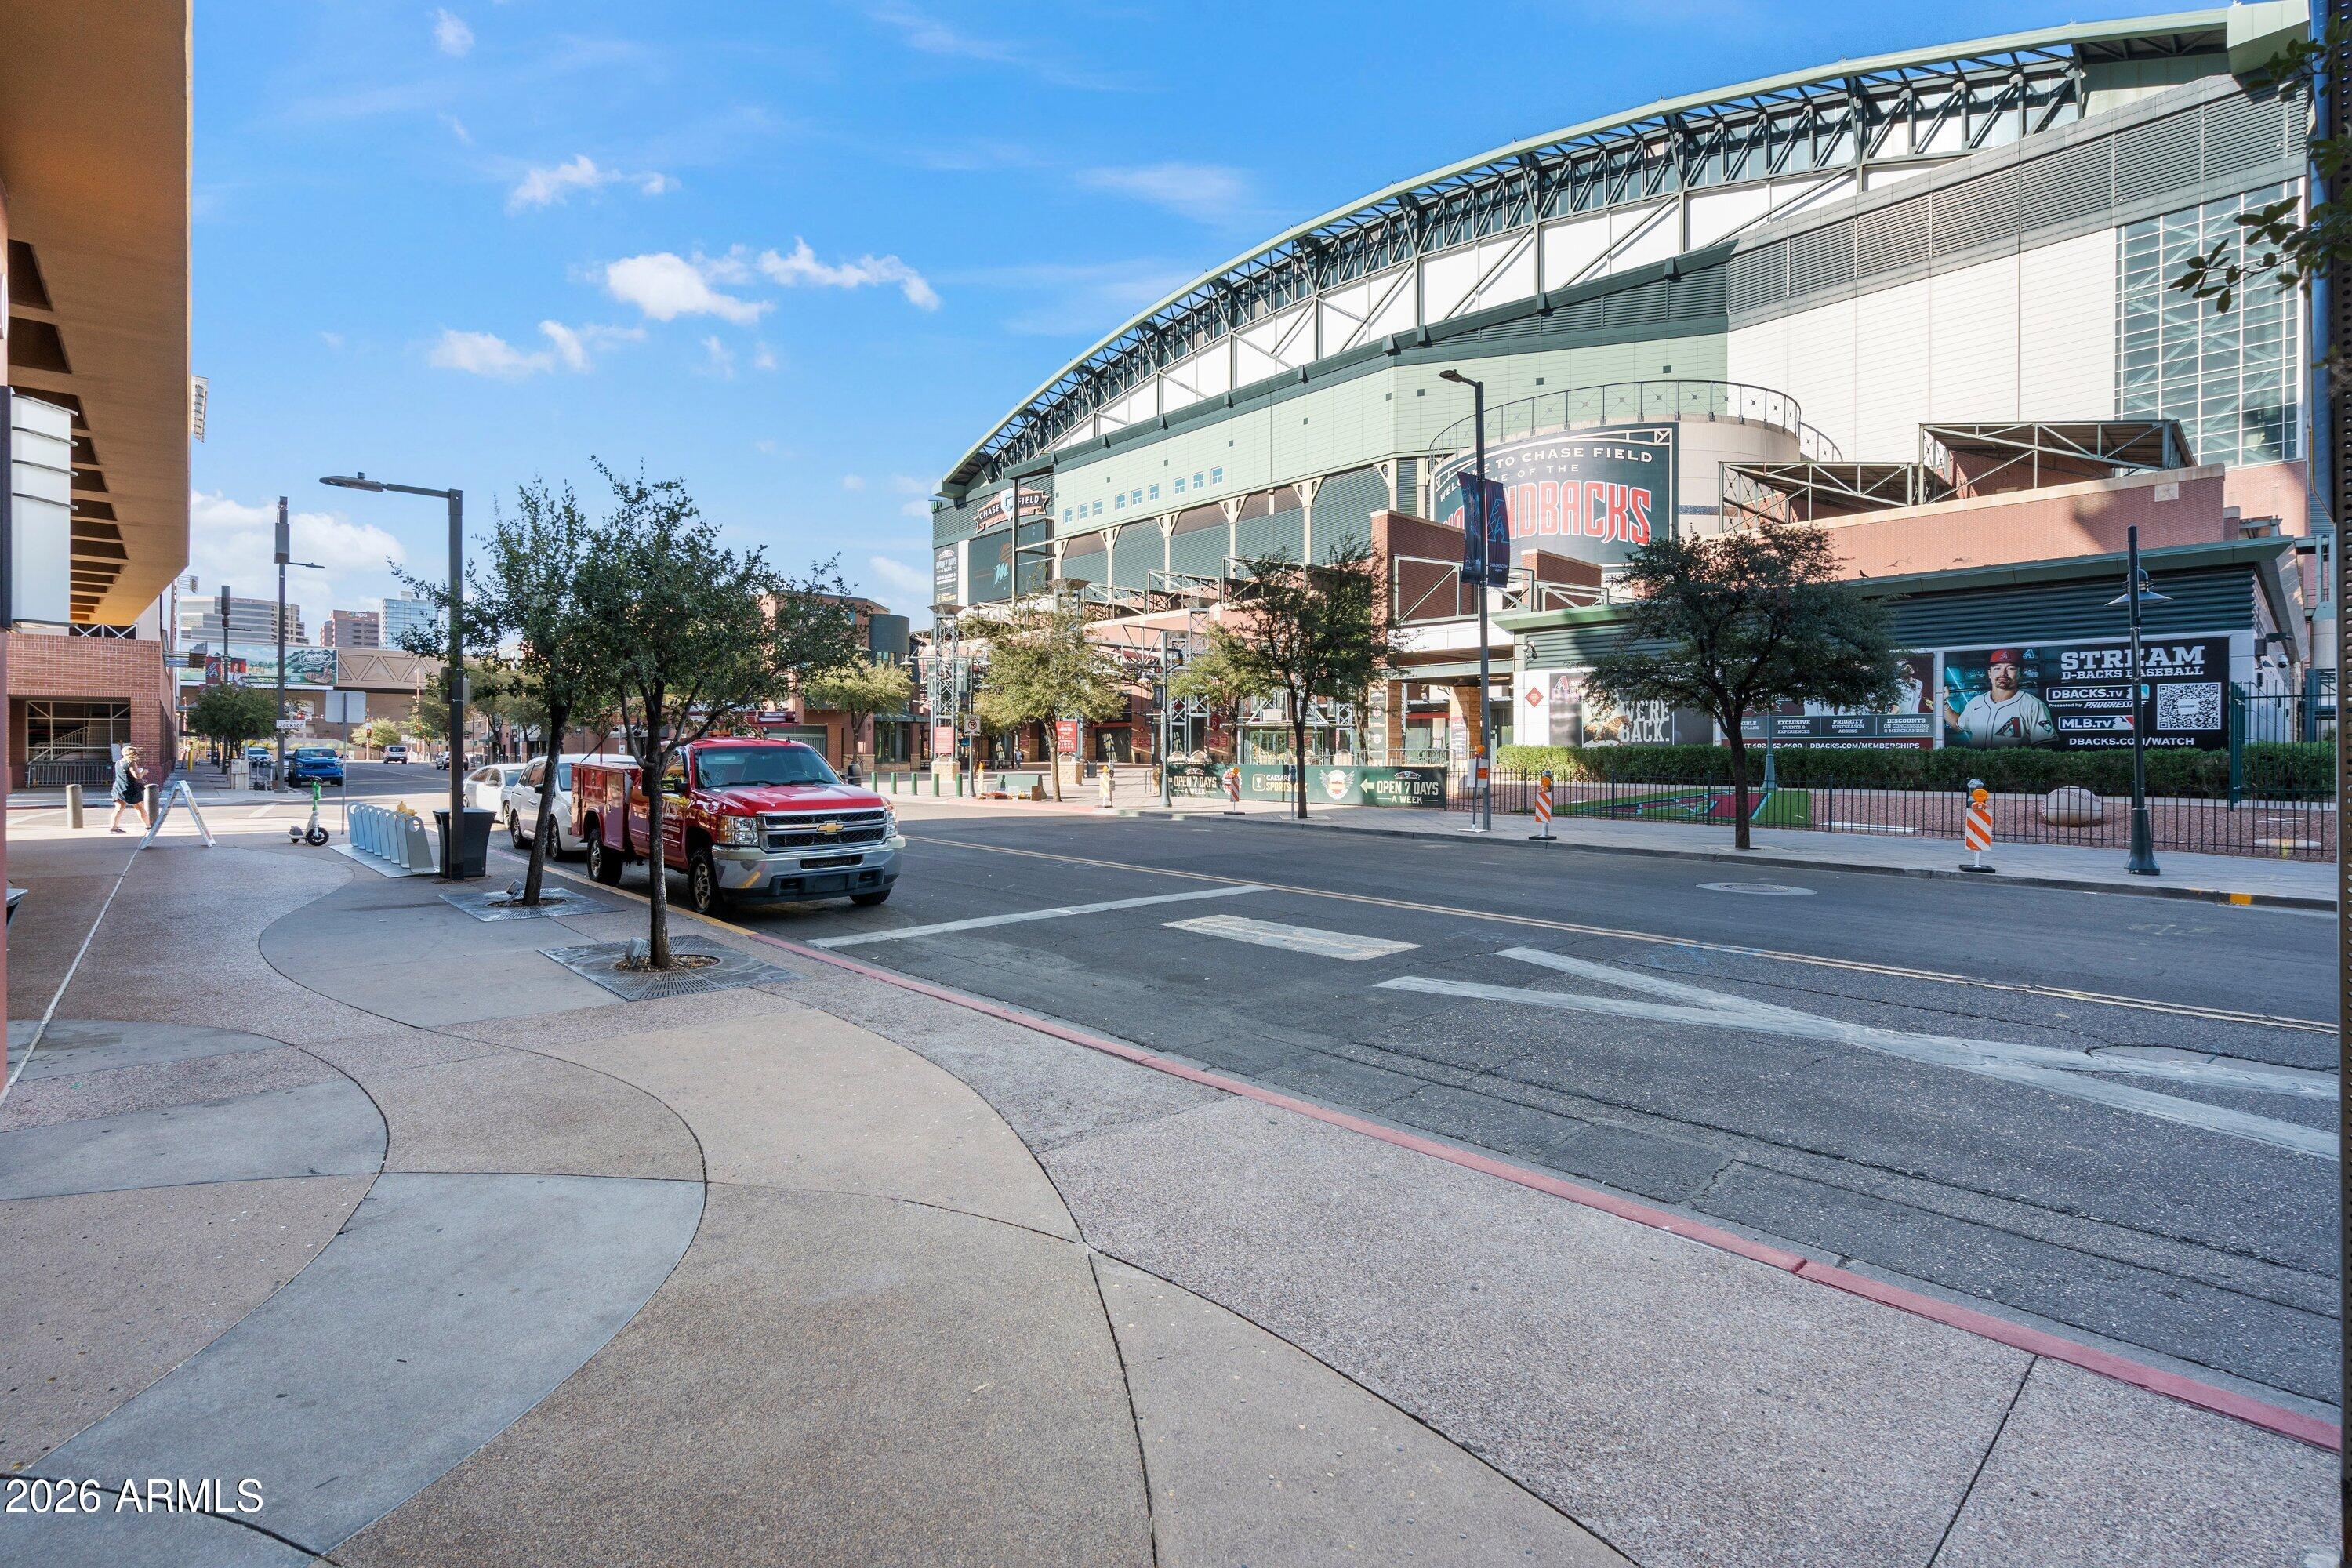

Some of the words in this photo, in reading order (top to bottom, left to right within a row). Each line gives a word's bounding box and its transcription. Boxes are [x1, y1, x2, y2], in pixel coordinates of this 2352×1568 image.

[1495, 456, 1515, 469] TO
[1522, 447, 1584, 463] CHASE
[1593, 447, 1653, 463] FIELD
[1517, 468, 1536, 478] OF
[1546, 464, 1579, 474] THE
[979, 504, 1000, 520] CHASE
[2061, 670, 2122, 681] D-BACKS
[2052, 688, 2124, 699] DBACKS.TV
[1621, 700, 1670, 722] WE'RE
[2062, 717, 2111, 728] MLB.TV
[1621, 720, 1670, 742] BACK.
[1174, 776, 1192, 787] OPEN
[1193, 776, 1198, 787] 7
[1199, 776, 1217, 788] DAYS
[1377, 780, 1402, 794] OPEN
[1404, 782, 1410, 794] 7
[1414, 782, 1439, 796] DAYS
